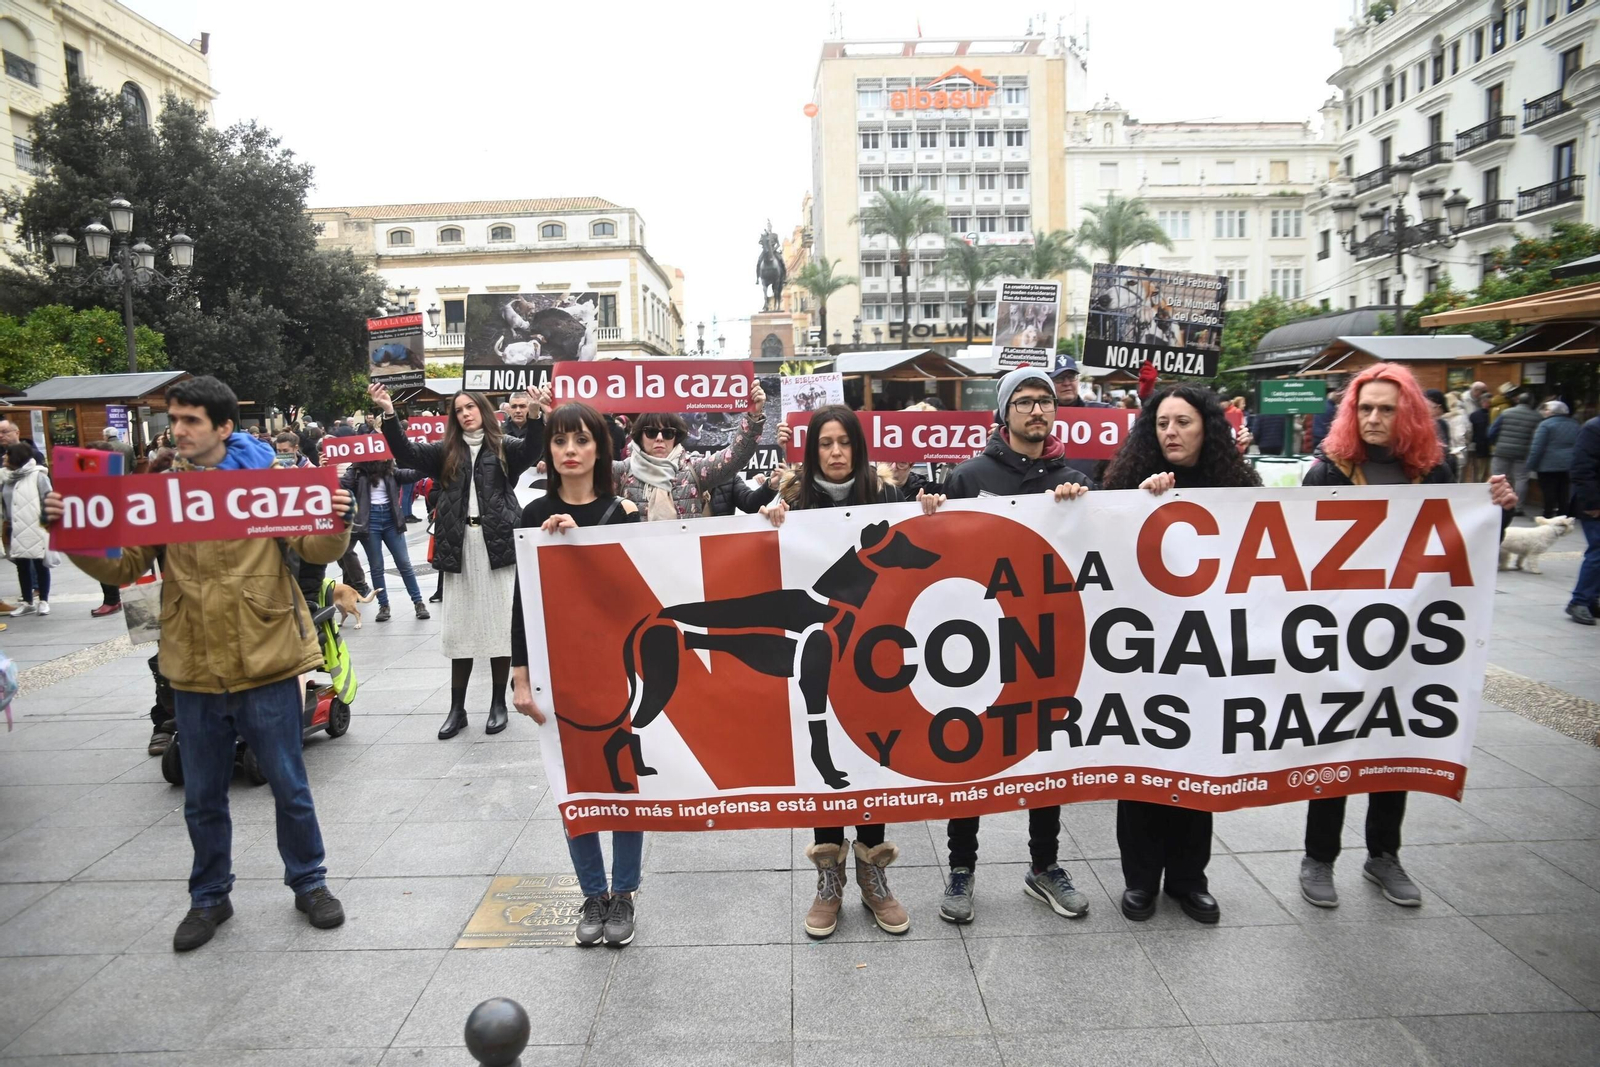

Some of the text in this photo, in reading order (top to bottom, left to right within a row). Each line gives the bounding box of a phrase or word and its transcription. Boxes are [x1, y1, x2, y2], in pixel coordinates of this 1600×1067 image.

[890, 87, 995, 111] albasur
[1173, 277, 1185, 286] de
[1187, 278, 1222, 290] Febrero
[1184, 298, 1220, 311] Mundial
[1174, 311, 1218, 326] del Galgo
[889, 322, 995, 338] ROLWN
[1105, 345, 1128, 367] NO
[1129, 347, 1140, 369] A
[1164, 351, 1204, 375] CAZA
[493, 370, 515, 390] NO
[516, 370, 527, 390] A
[554, 365, 748, 398] no a la caza
[795, 375, 840, 385] BIBLIOTECAS
[686, 402, 733, 410] plataformanac.org
[411, 422, 445, 434] no a
[873, 415, 904, 448] la
[911, 424, 987, 447] caza
[1056, 421, 1119, 445] no a
[326, 436, 385, 458] no a la
[62, 478, 333, 528] no a la caza
[247, 523, 313, 535] plataformanac.org
[984, 498, 1474, 600] A LA CAZA
[853, 600, 1465, 693] CON GALGOS
[866, 684, 1458, 767] Y OTRAS RAZAS
[1358, 765, 1456, 781] plataformanac.org
[565, 771, 1268, 820] Cuanto más indefensa está una criatura, más derecho tiene a ser defendida
